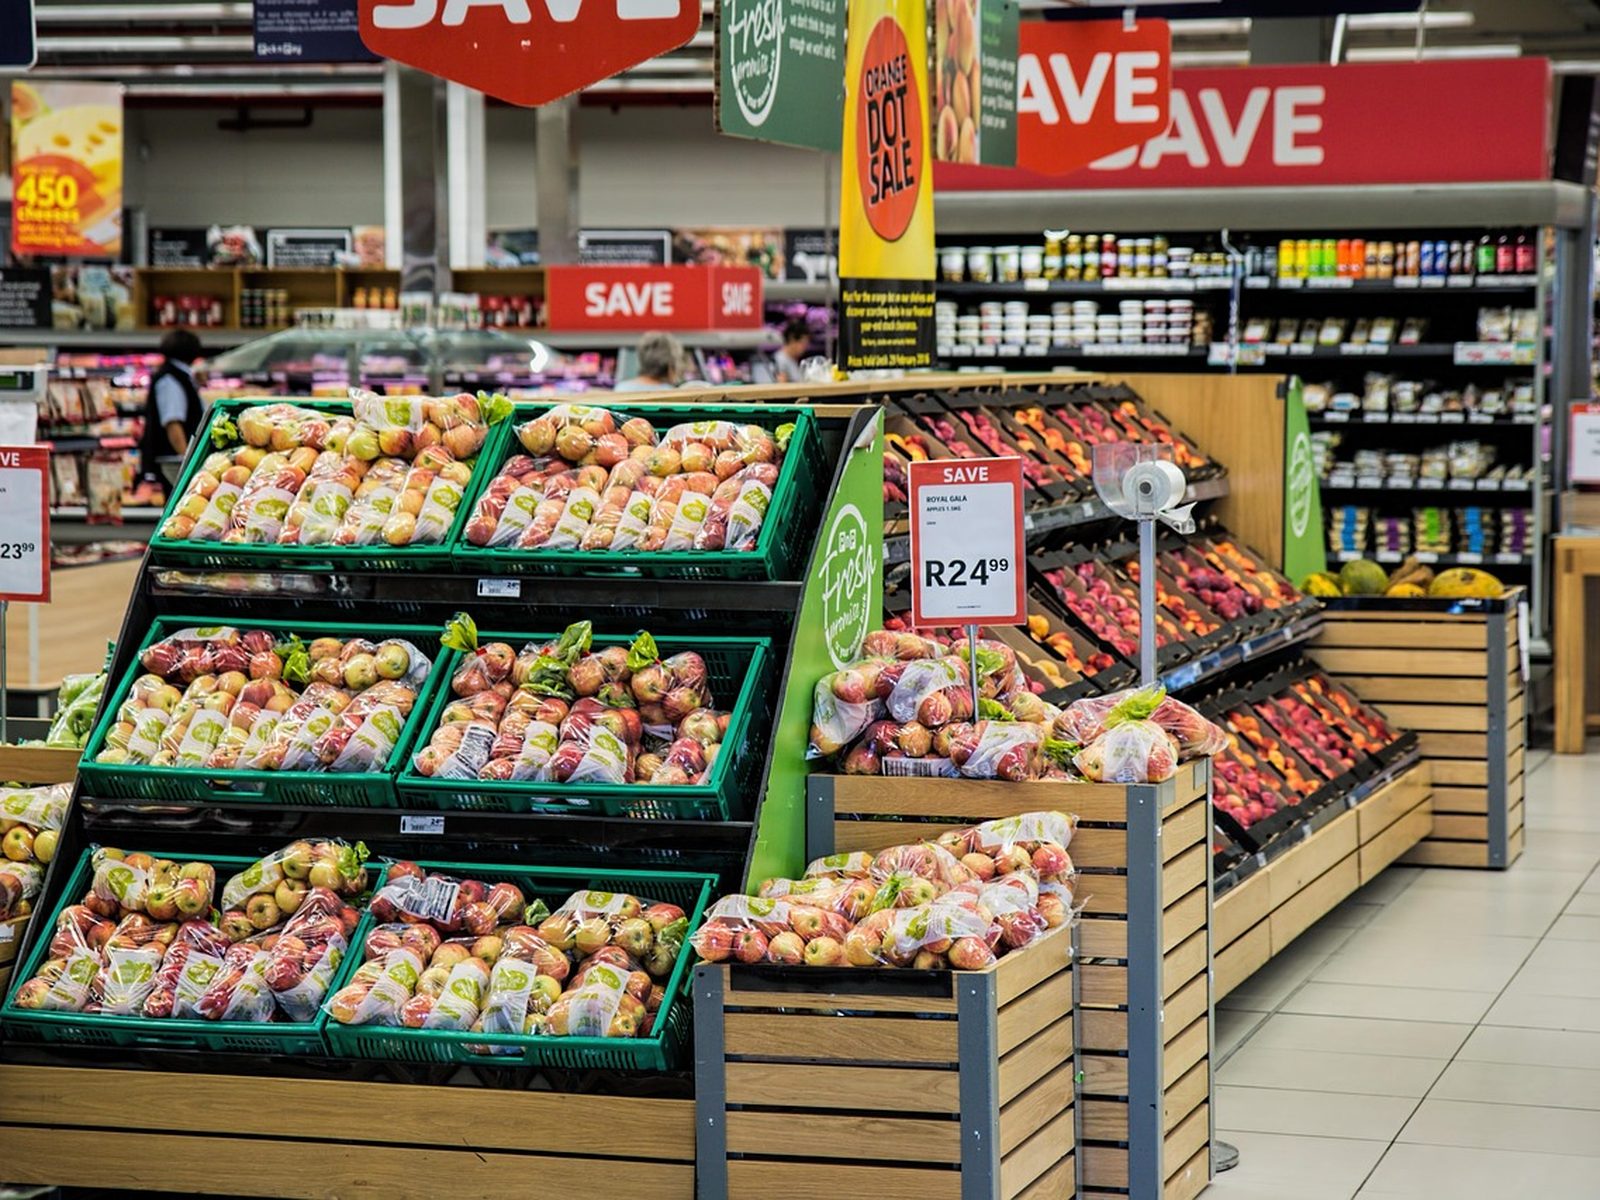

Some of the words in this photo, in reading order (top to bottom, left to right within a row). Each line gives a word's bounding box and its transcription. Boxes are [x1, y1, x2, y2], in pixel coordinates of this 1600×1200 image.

[866, 54, 907, 97] ORANGE
[1018, 51, 1161, 125] AVE
[866, 87, 907, 156] DOT
[16, 175, 78, 208] 450
[869, 141, 914, 205] SALE
[585, 281, 674, 317] SAVE
[722, 281, 753, 317] SAVE
[0, 452, 20, 467] VE
[943, 466, 989, 483] SAVE
[819, 521, 877, 611] Fresh
